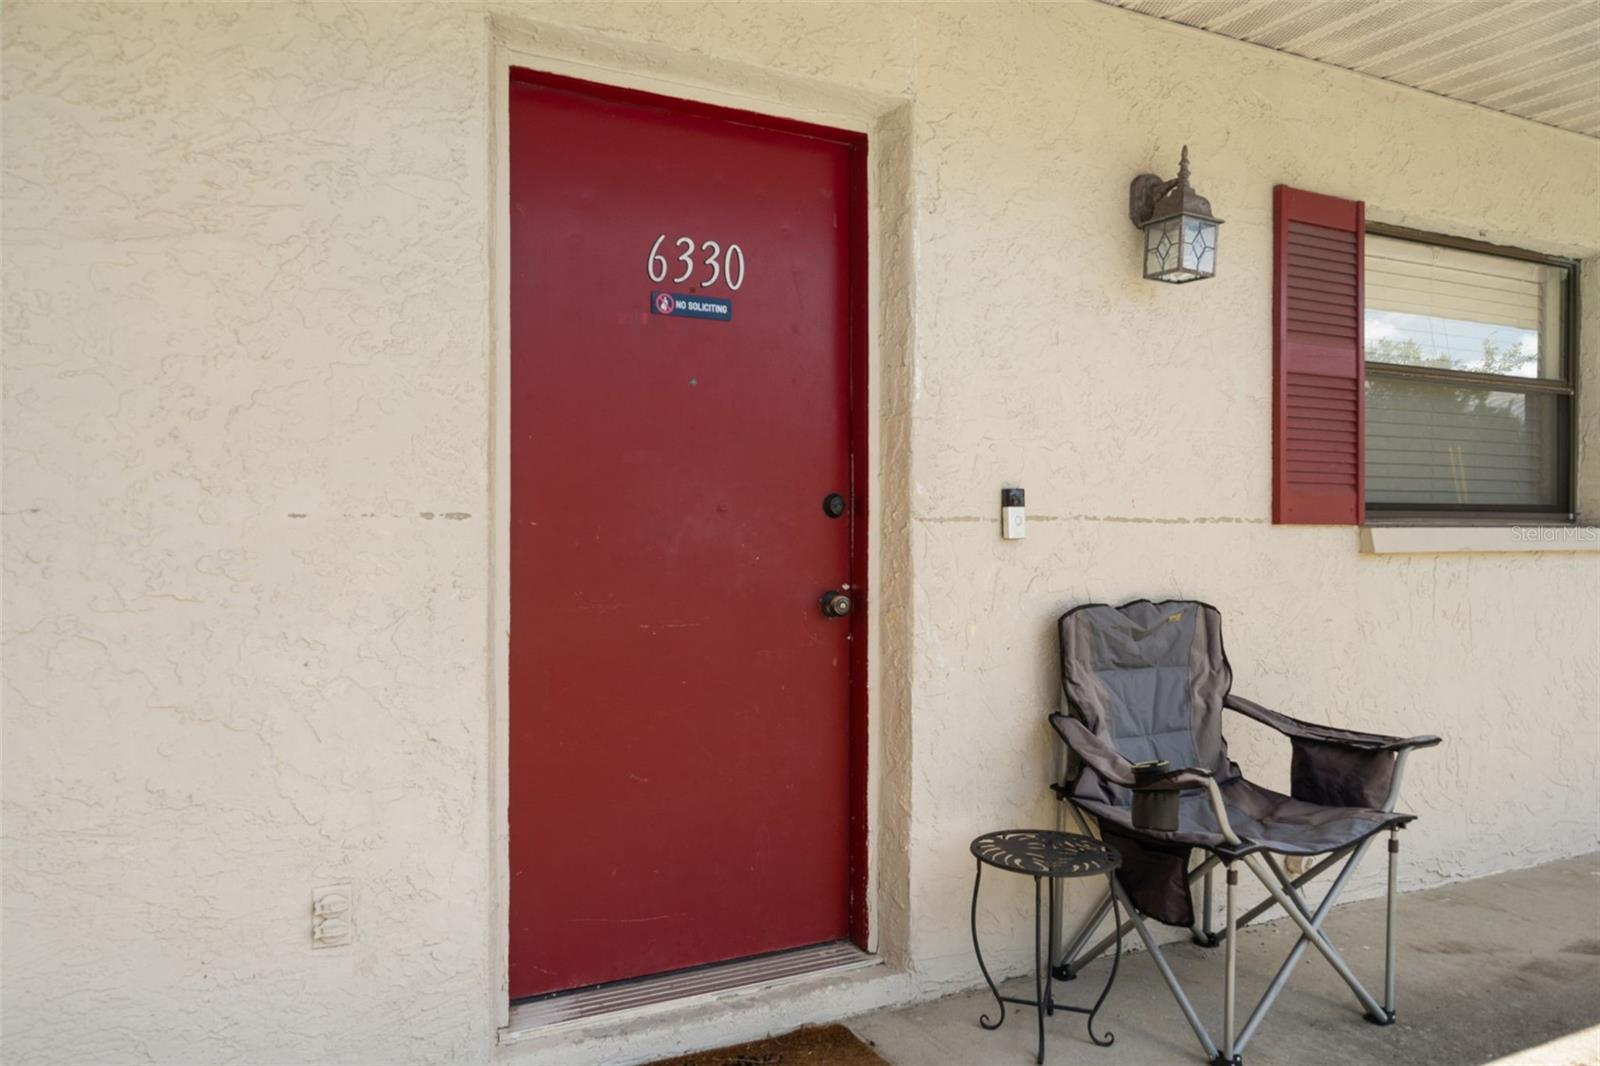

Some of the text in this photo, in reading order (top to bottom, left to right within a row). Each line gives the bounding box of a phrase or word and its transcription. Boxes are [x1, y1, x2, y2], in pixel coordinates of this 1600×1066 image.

[648, 234, 745, 290] 6330
[675, 300, 728, 314] NO SOLICITING
